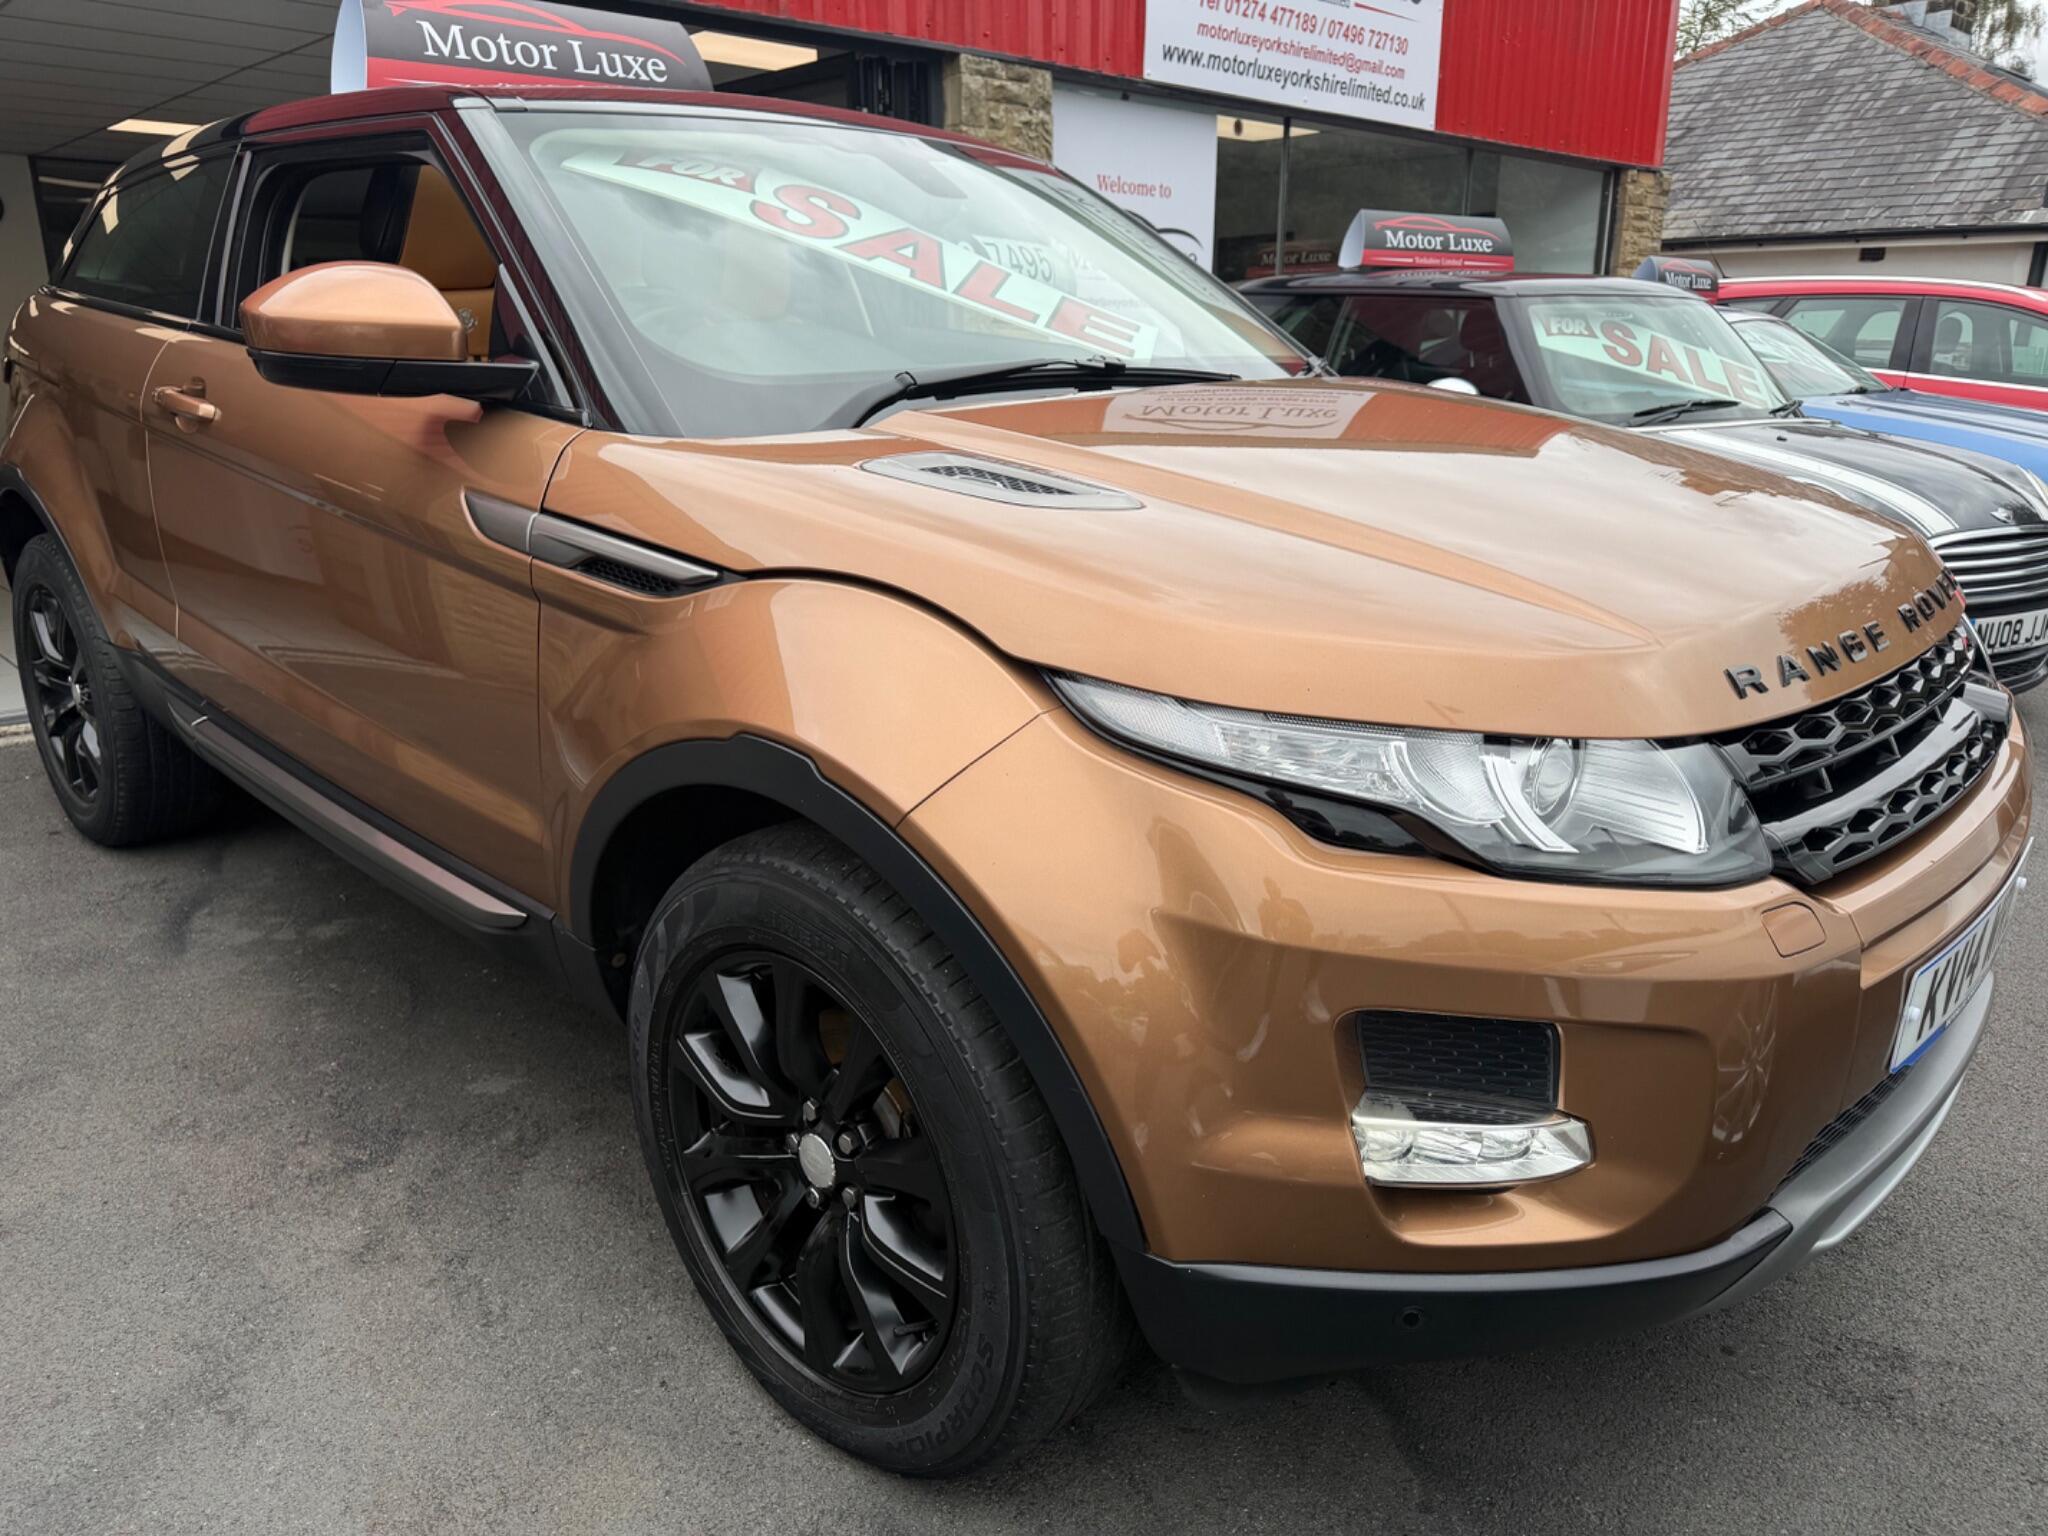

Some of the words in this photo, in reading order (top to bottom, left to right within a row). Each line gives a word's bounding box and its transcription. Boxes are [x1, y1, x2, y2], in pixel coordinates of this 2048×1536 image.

[415, 20, 558, 70] Motor
[566, 39, 668, 83] Luxe
[1197, 22, 1406, 80] motorluxeyorkshirelimited@gmail.com
[1224, 0, 1267, 22] 01274
[1269, 5, 1317, 36] 477189
[1327, 20, 1365, 45] 07496
[1368, 29, 1409, 56] 727130
[1162, 44, 1426, 112] www.motorluxeyorkshirelimited.co.uk
[636, 157, 746, 186] FOR
[1096, 174, 1157, 198] Welcome
[1159, 182, 1173, 198] to
[982, 241, 1053, 281] 7495
[1384, 229, 1444, 249] Motor
[1448, 232, 1493, 253] Luxe
[750, 184, 1141, 359] SALE
[1665, 271, 1691, 288] Motor
[1692, 273, 1712, 289] Luxe
[1550, 316, 1589, 336] FOR
[1600, 320, 1766, 408] SALE
[1977, 618, 2024, 649] NU08
[1723, 620, 1890, 700] RANGE
